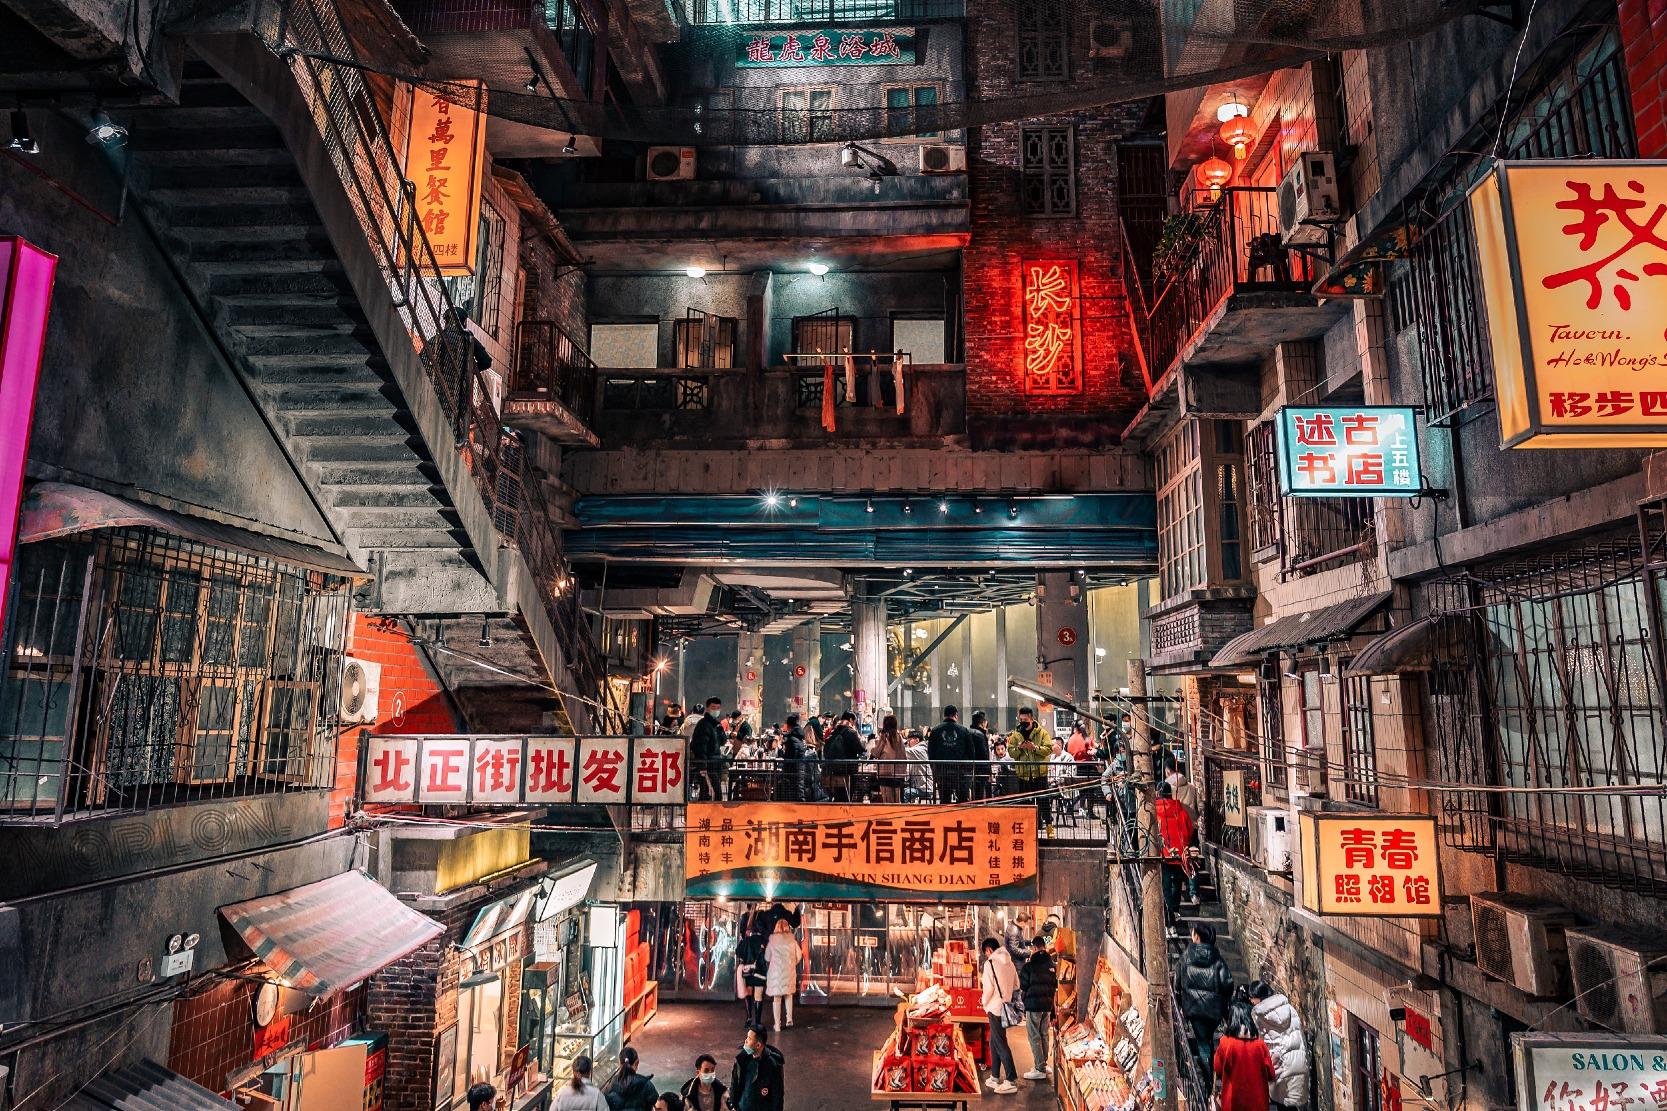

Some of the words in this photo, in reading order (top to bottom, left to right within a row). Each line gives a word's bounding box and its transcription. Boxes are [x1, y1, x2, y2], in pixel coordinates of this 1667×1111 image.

[745, 33, 900, 62] 龍虎泉浴城
[1025, 265, 1071, 374] 长沙
[1292, 413, 1380, 447] 述古
[1296, 452, 1385, 485] 书店
[372, 748, 683, 793] 北正街批发部
[721, 818, 733, 881] 品种丰
[745, 819, 976, 866] 湖南手信商店
[987, 822, 1000, 886] 赠礼佳品
[1340, 828, 1419, 869] 青春
[881, 873, 933, 885] SHANG
[939, 874, 976, 885] DIAN
[1334, 874, 1431, 905] 照相馆
[1571, 1052, 1645, 1071] SALON
